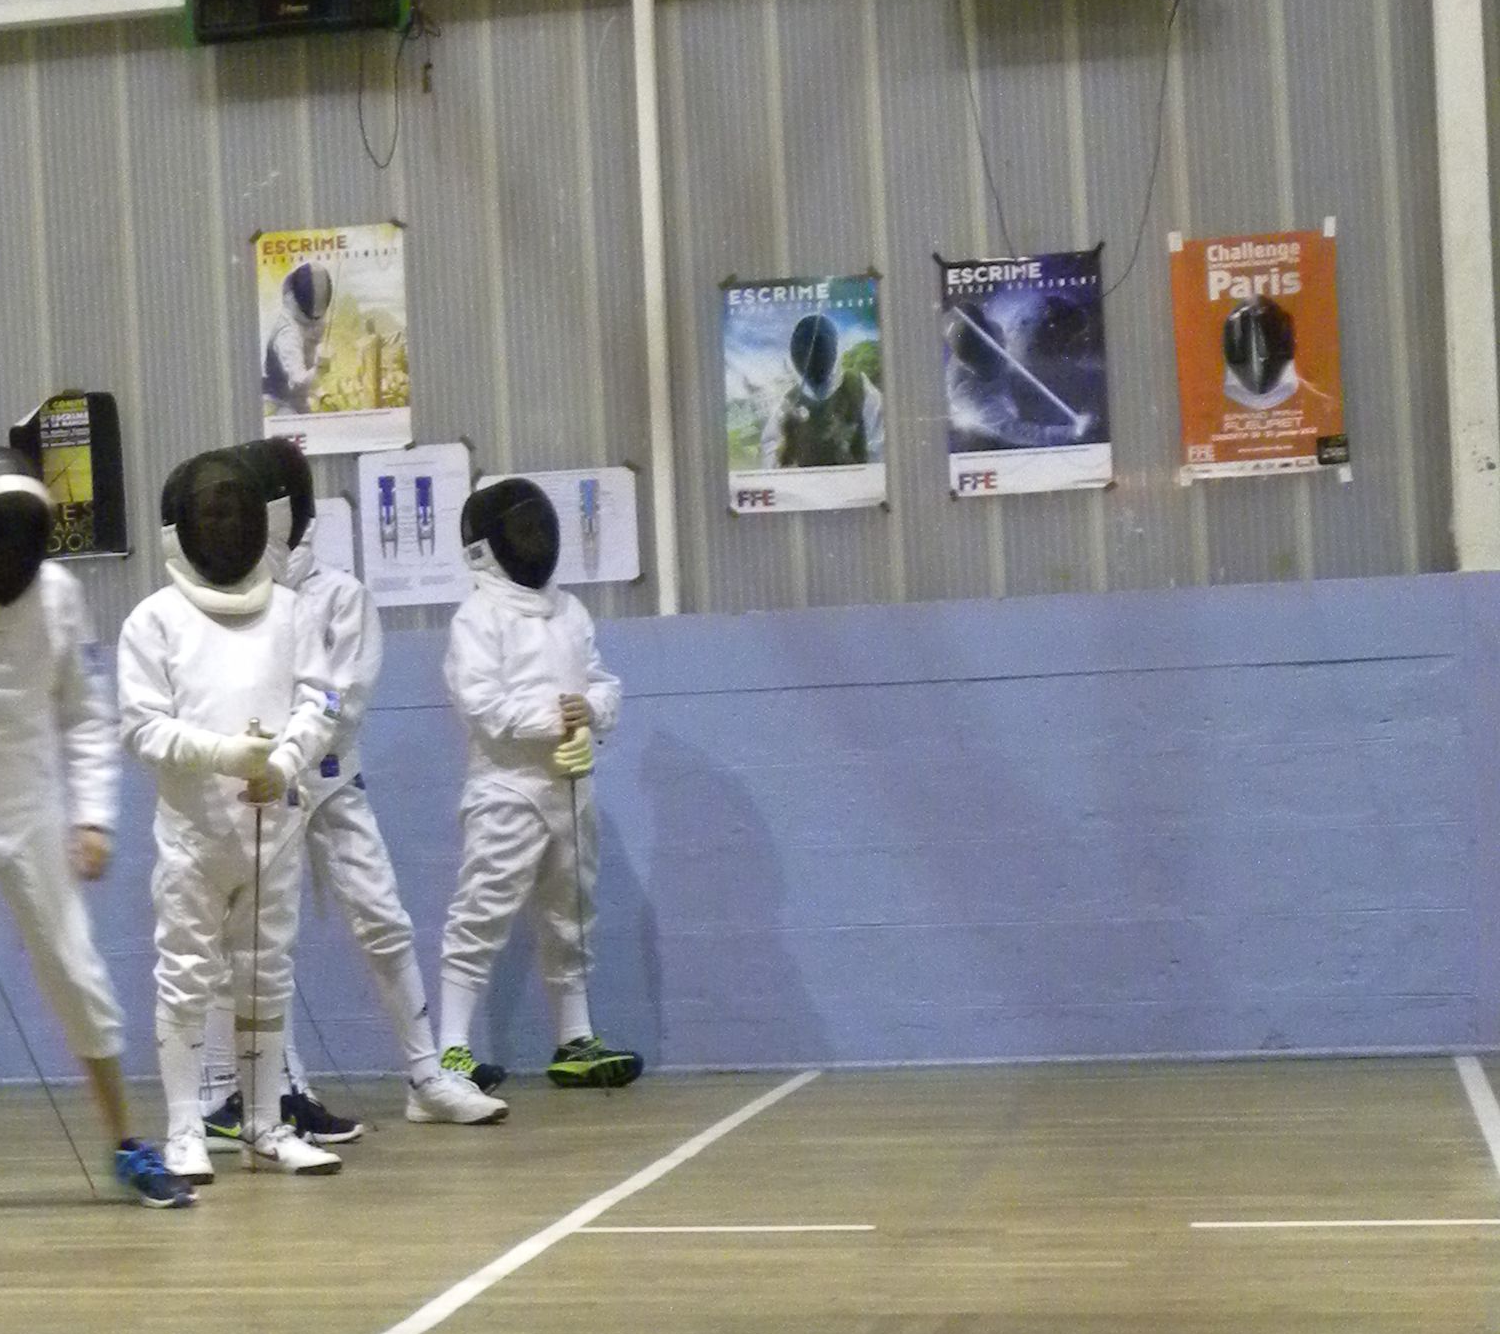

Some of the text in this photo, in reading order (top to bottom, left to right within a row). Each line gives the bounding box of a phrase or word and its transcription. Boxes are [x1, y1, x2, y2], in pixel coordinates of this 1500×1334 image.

[262, 234, 348, 256] ESCRIME
[1207, 241, 1301, 262] Challenge
[947, 261, 1042, 285] ESCRIME
[1208, 267, 1302, 301] Paris
[728, 282, 830, 306] ESCRIME
[958, 470, 998, 491] FFE
[737, 489, 776, 508] FFE
